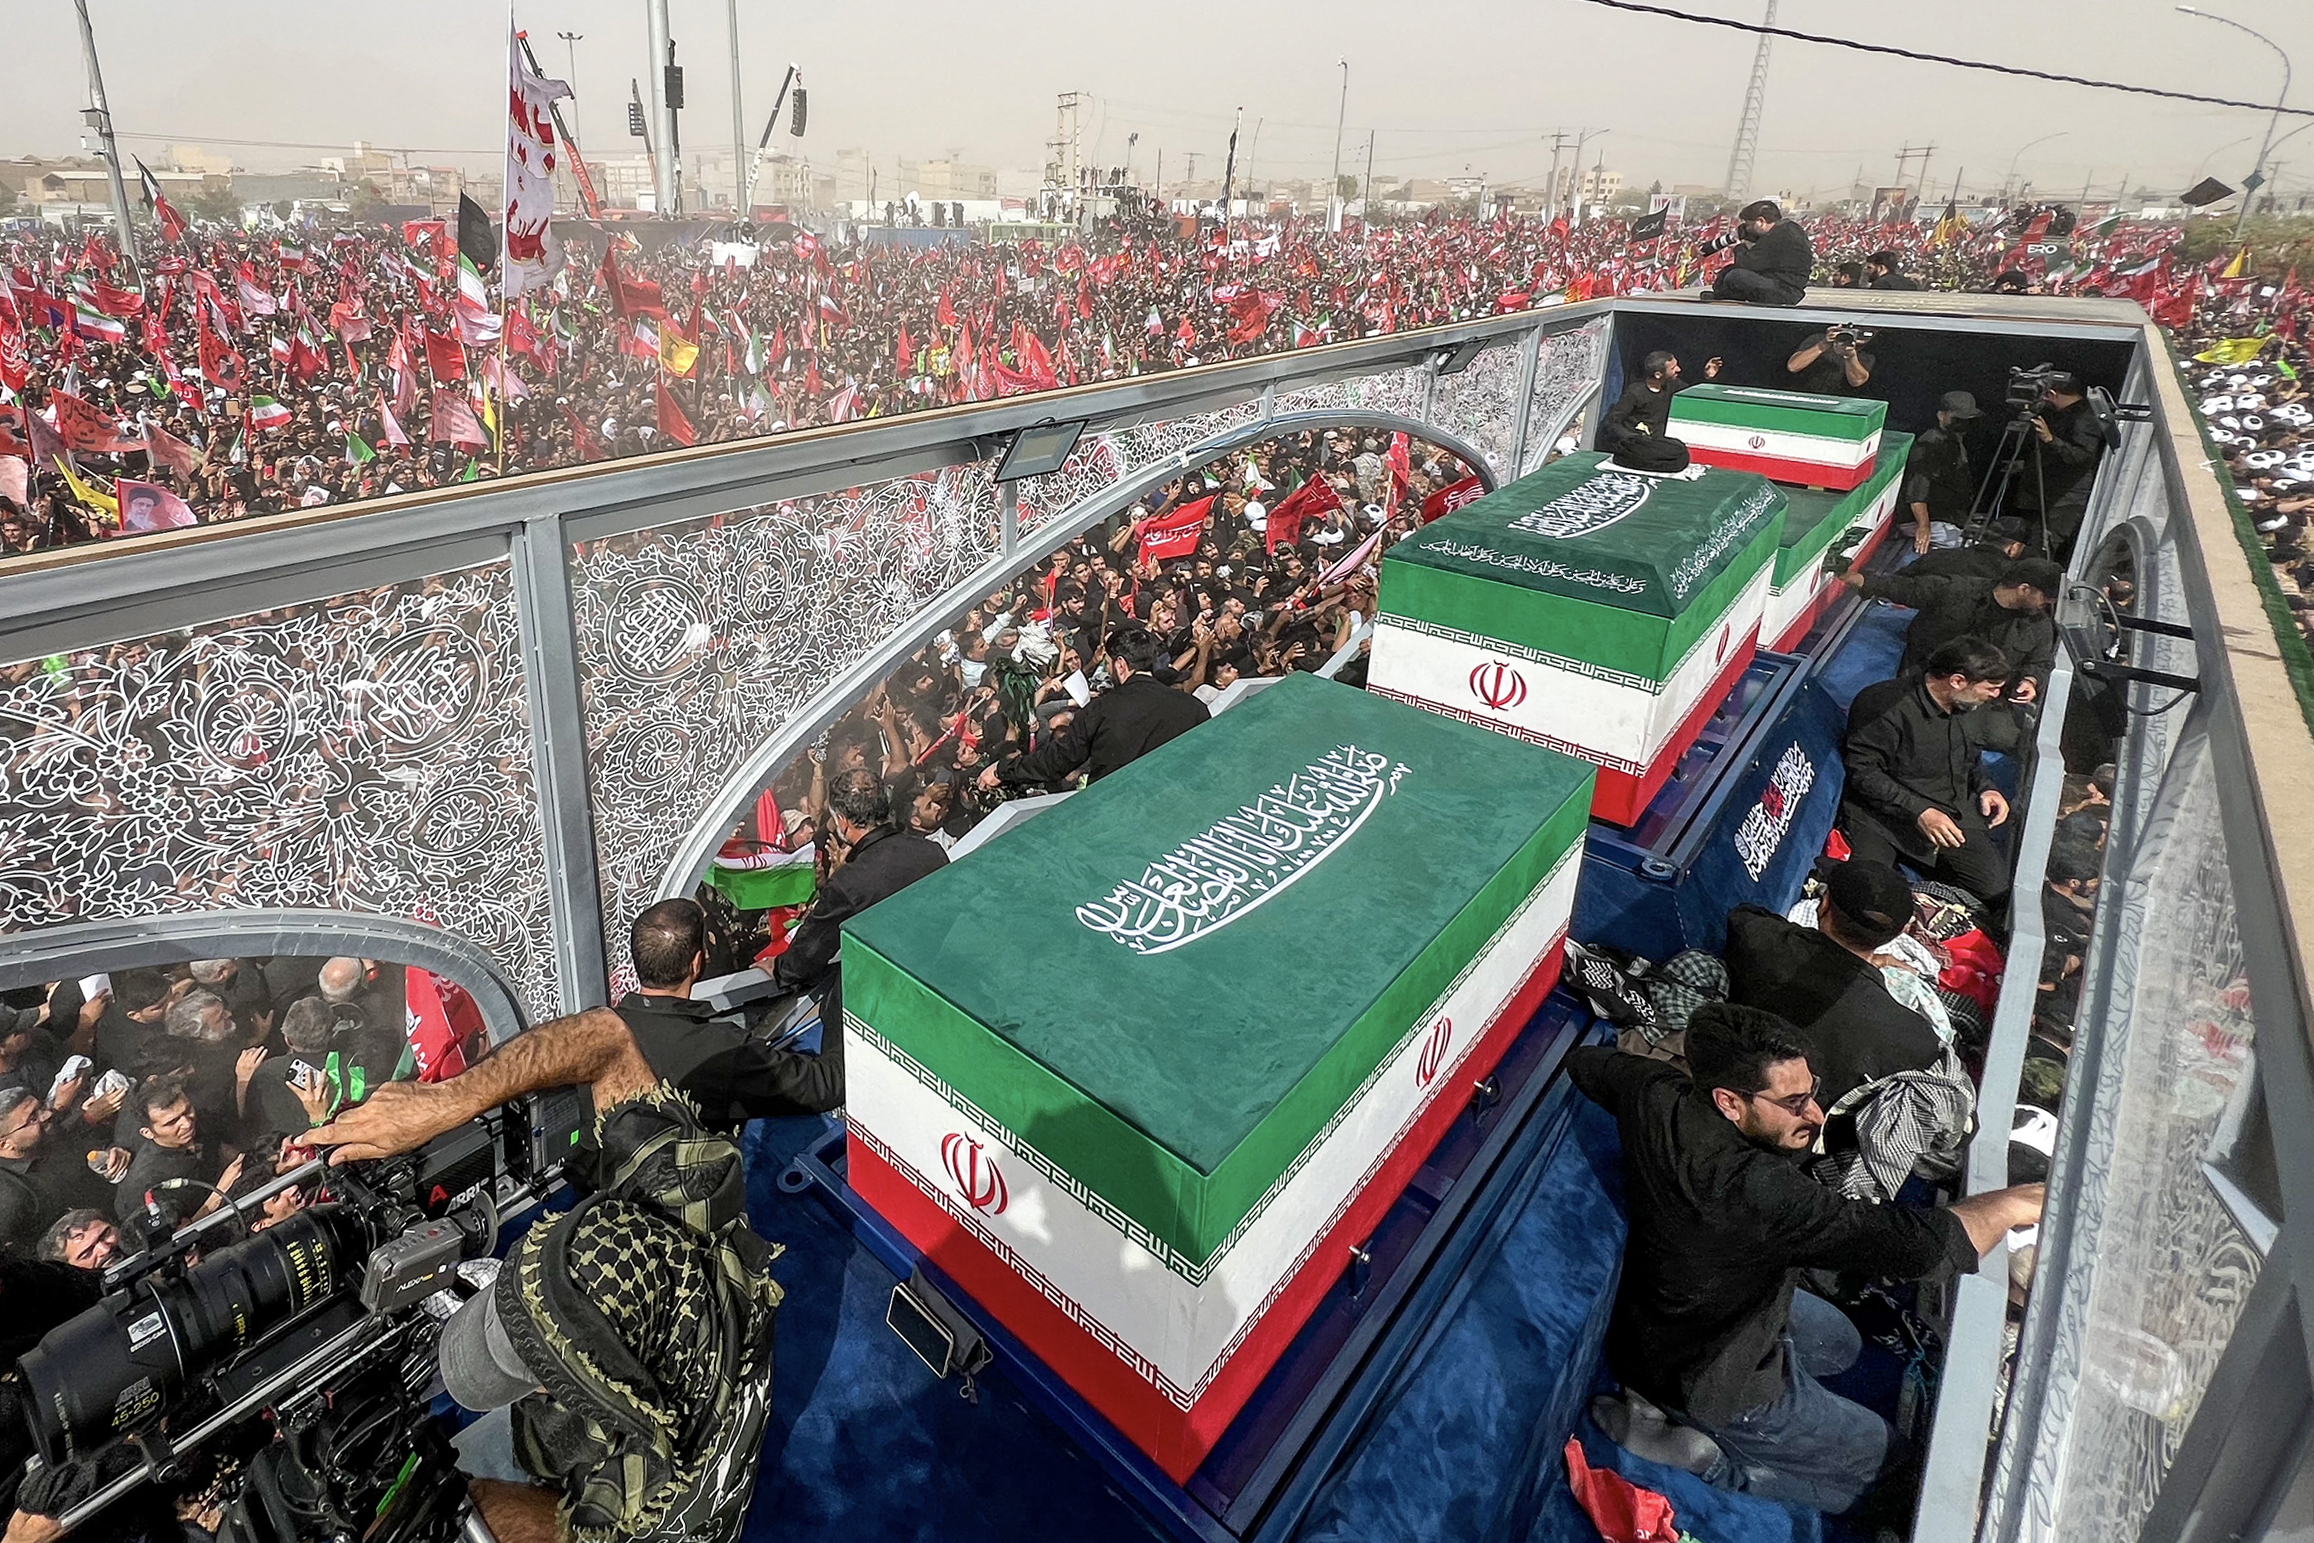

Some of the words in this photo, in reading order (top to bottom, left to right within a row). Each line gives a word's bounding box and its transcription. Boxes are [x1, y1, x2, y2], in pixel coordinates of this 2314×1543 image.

[444, 1183, 481, 1215] ARRI
[115, 1376, 150, 1407] ARRI
[111, 1392, 160, 1426] 45-250
